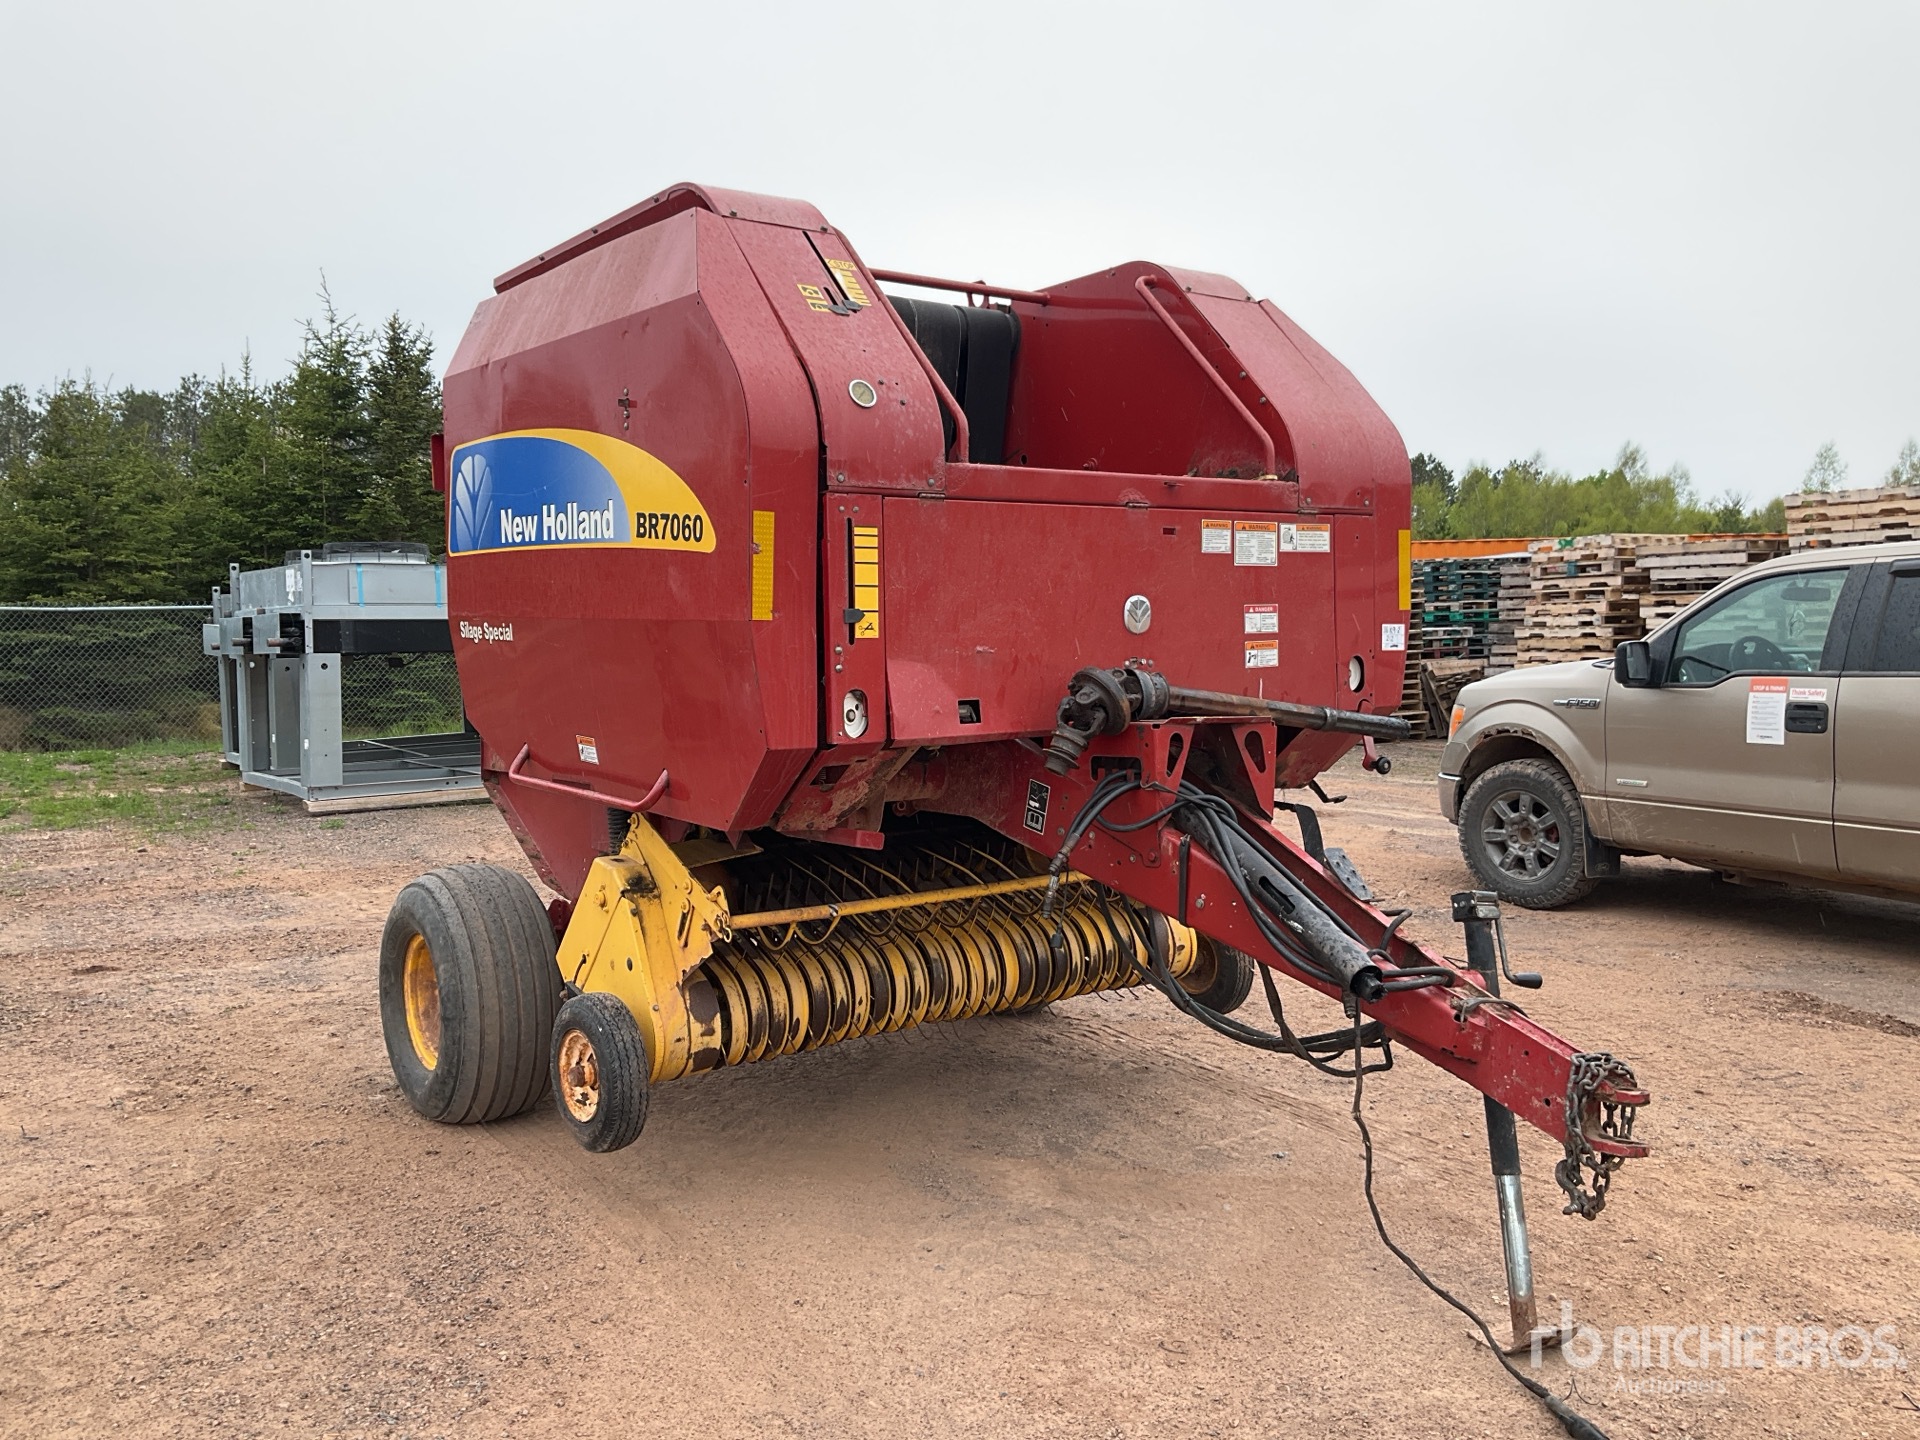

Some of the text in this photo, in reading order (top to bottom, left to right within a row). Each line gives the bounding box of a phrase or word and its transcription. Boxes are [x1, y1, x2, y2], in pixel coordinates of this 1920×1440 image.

[833, 260, 854, 268] STOP
[501, 499, 614, 544] New Holland
[635, 511, 704, 543] BR7060
[460, 620, 513, 644] Silage Special
[1807, 689, 1825, 697] Safety
